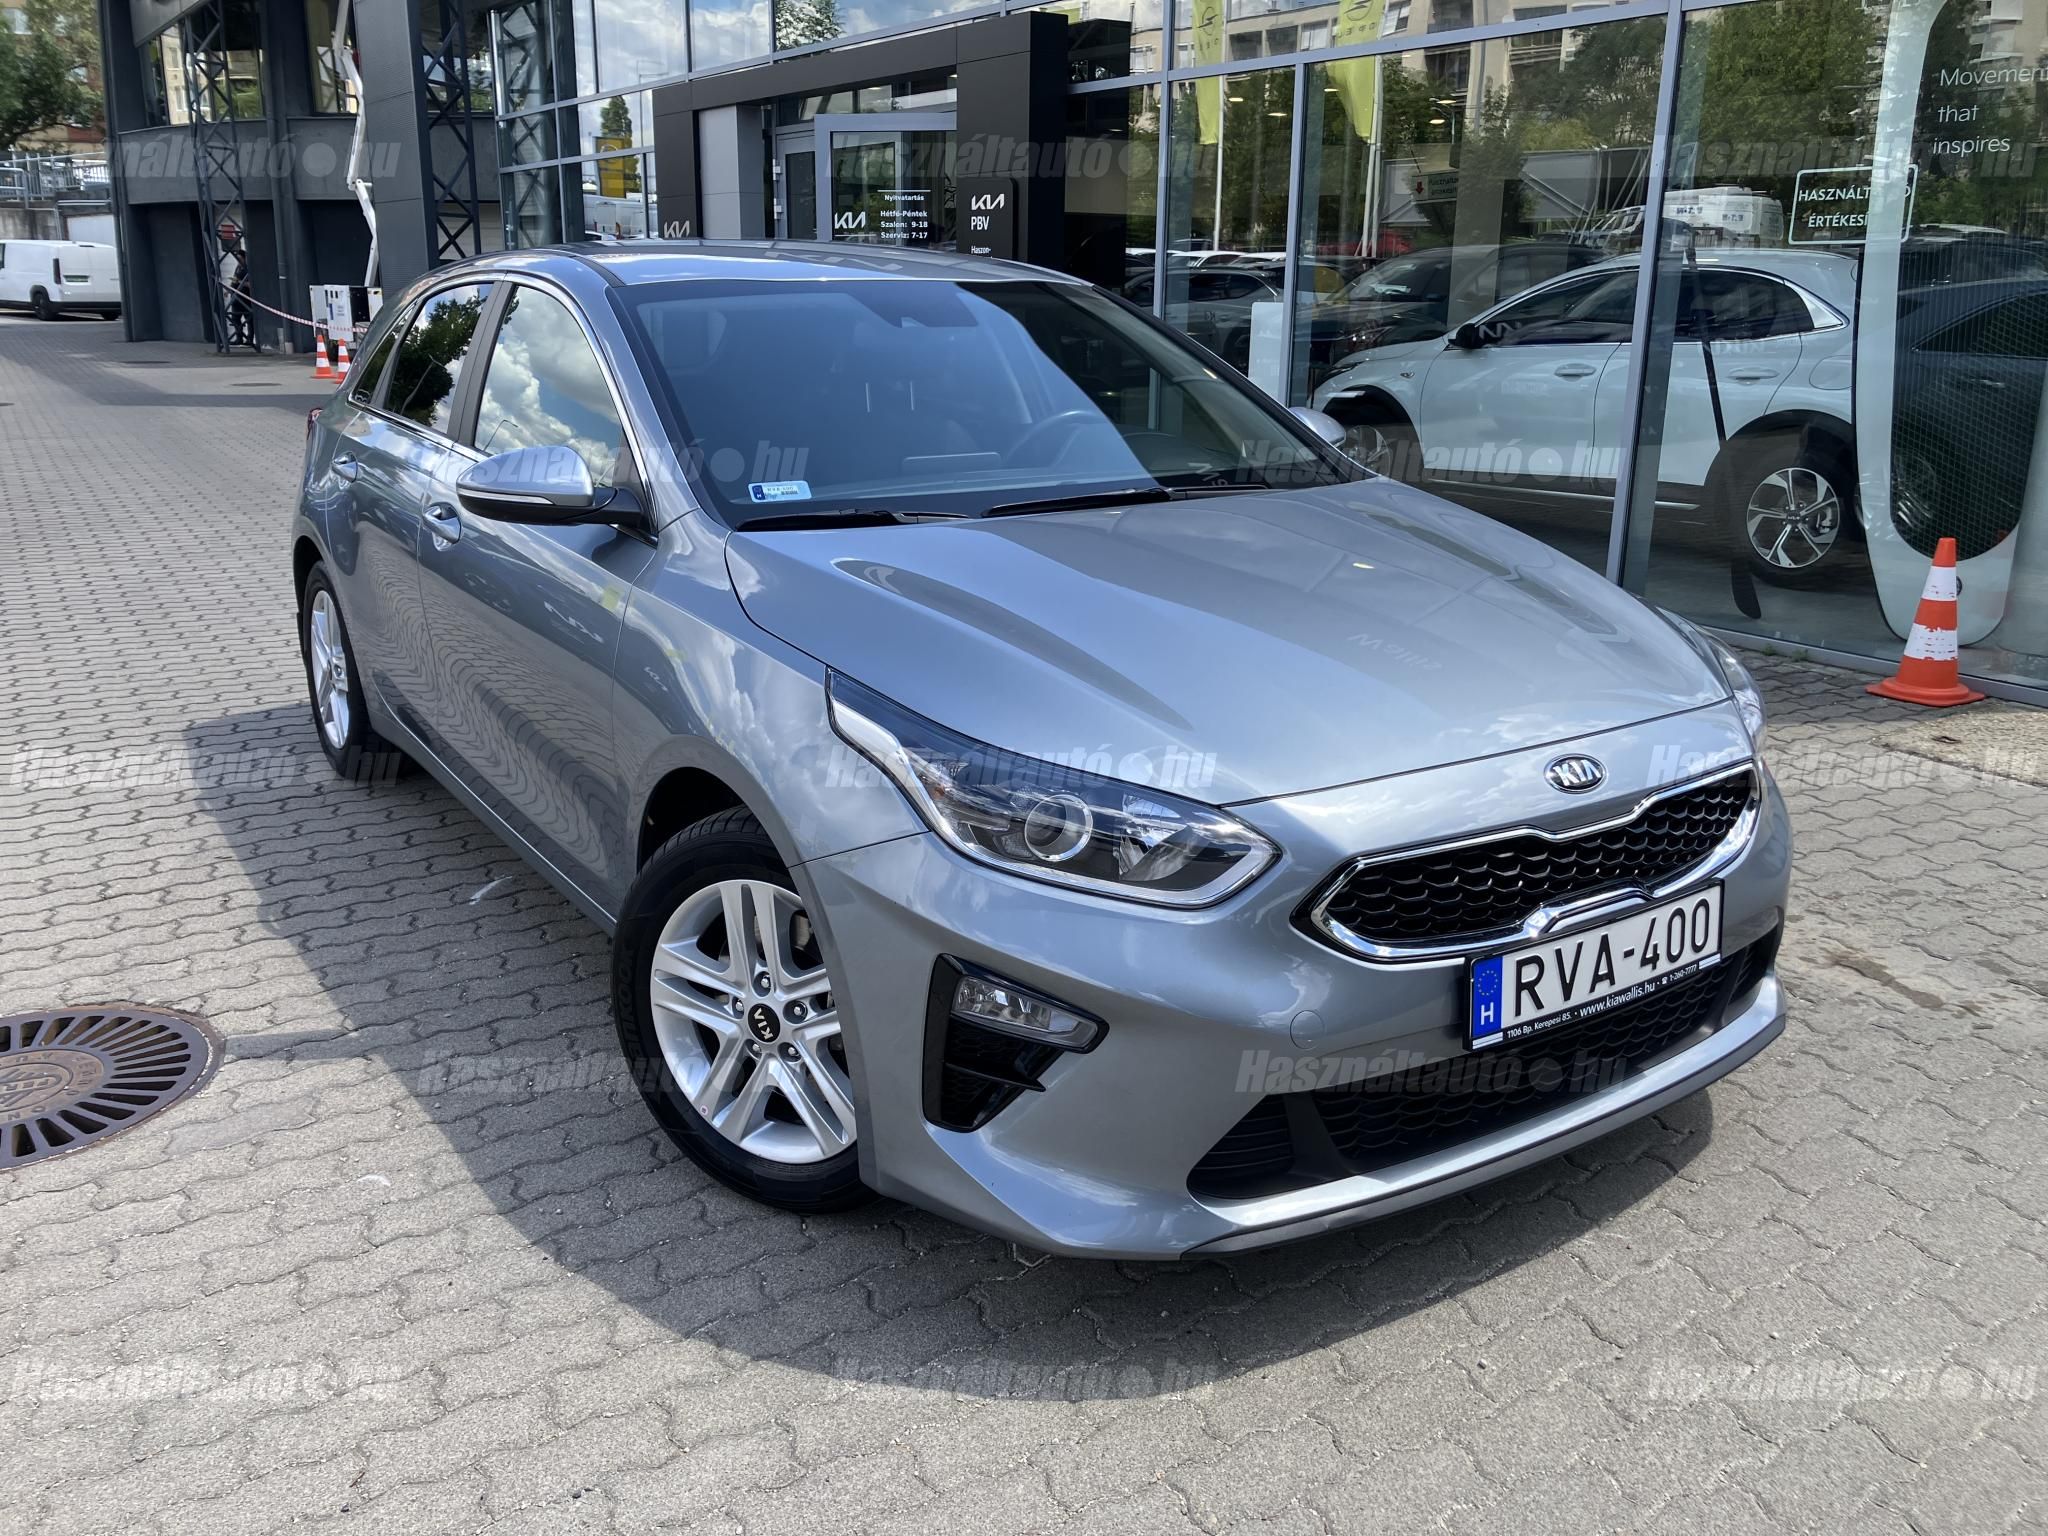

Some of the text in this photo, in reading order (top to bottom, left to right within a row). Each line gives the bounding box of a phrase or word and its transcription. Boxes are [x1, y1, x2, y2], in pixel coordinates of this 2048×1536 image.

[1940, 67, 2048, 86] Movemen
[1938, 104, 1980, 122] that
[1933, 135, 2010, 157] inspires
[971, 193, 1005, 211] KIA
[1798, 184, 1911, 201] HASZNÁLT
[834, 211, 866, 230] KIA
[880, 220, 928, 229] Szalon: 9-18
[970, 215, 990, 231] PBV
[880, 231, 928, 240] Szerviz: 7-17
[1553, 759, 1602, 786] KIA
[1514, 897, 1711, 1018] RVA-400
[1480, 1002, 1494, 1026] H
[1506, 1029, 1522, 1039] 1106
[1522, 1025, 1533, 1035] Bp.
[1534, 1014, 1562, 1030] Kerepesi
[1579, 981, 1656, 1018] www.kiawallis.hu
[753, 1007, 774, 1040] KIA
